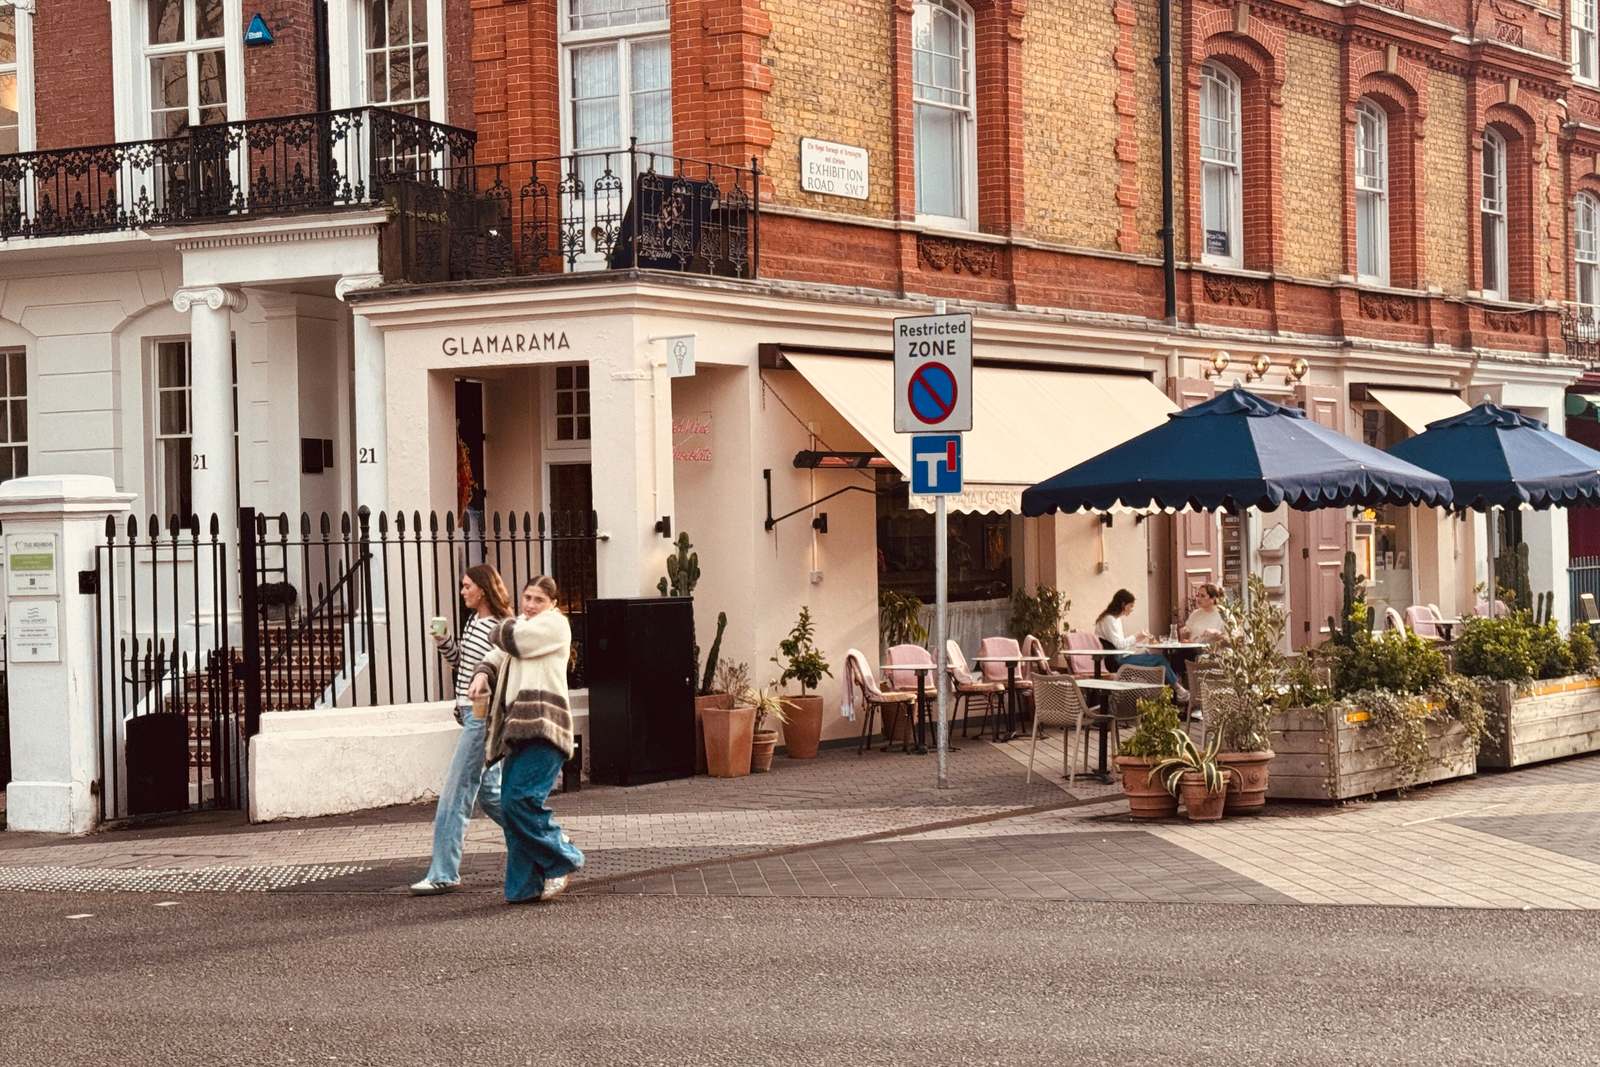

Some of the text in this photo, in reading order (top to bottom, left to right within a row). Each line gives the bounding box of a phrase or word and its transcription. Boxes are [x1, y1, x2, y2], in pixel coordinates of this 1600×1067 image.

[809, 161, 863, 182] EXHIBITION
[900, 320, 966, 338] Restricted
[442, 331, 571, 357] GLAMARAMA
[908, 339, 956, 358] ZONE
[192, 454, 208, 470] 21
[359, 447, 377, 464] 21
